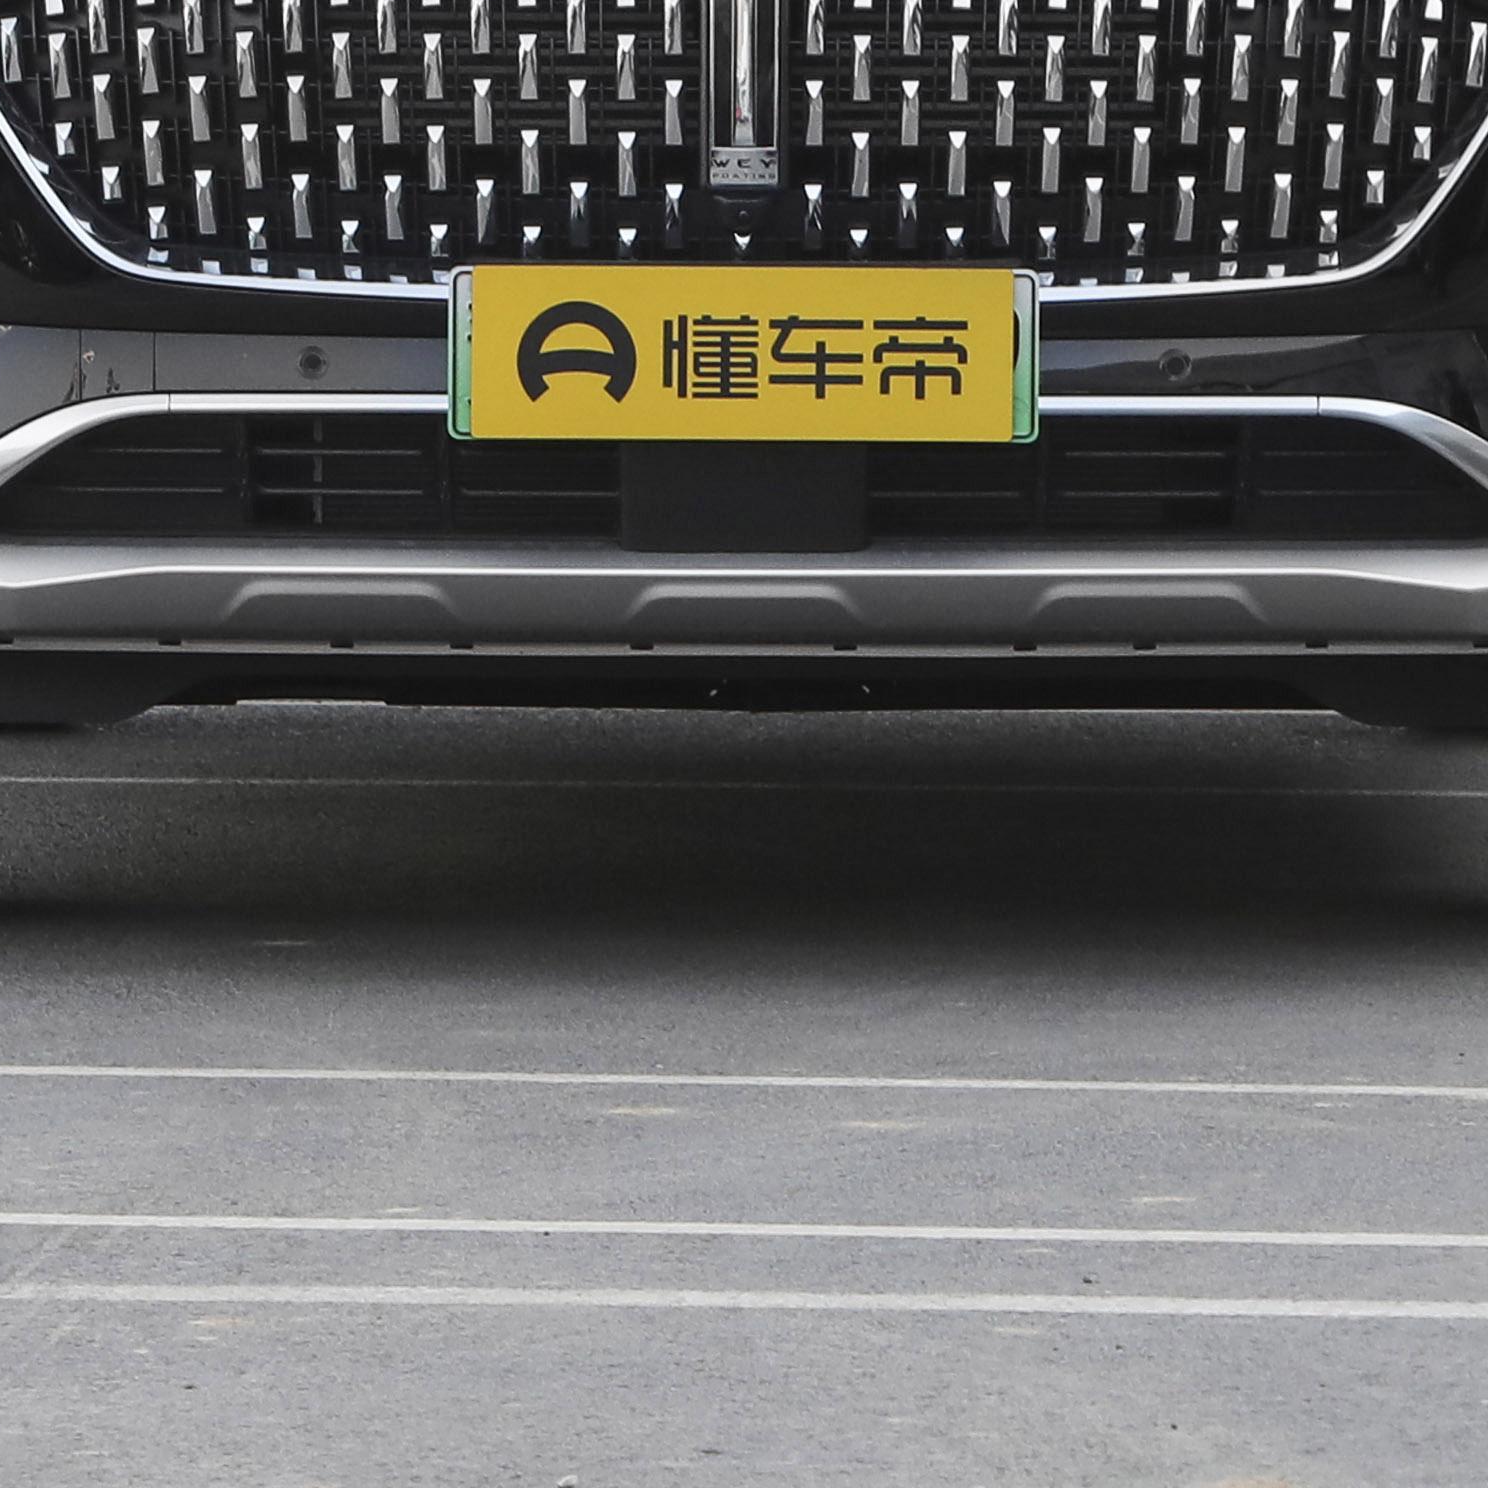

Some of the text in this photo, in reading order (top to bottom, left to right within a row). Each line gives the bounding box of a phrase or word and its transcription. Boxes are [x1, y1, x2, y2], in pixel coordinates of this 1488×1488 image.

[713, 158, 777, 169] WEY
[663, 315, 968, 400] 懂车帝
